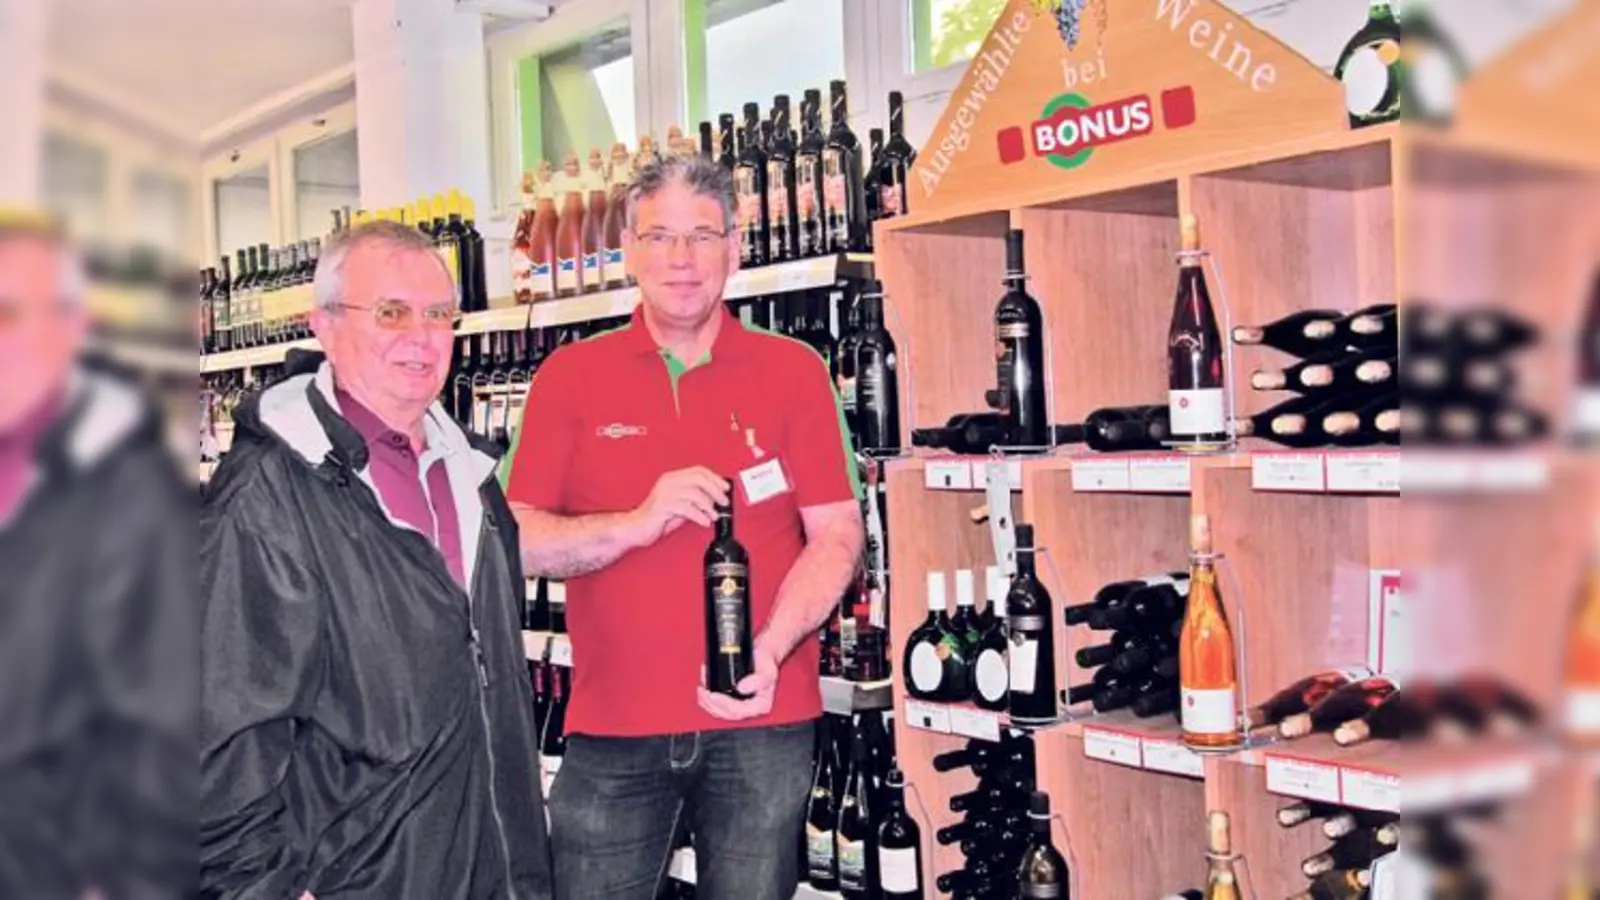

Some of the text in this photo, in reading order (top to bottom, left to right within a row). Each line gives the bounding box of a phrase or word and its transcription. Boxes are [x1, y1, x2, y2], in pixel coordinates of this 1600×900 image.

[1062, 49, 1108, 88] bei
[1155, 0, 1276, 92] Weine
[918, 11, 1031, 198] Ausgewählte
[1035, 101, 1151, 151] BONUS
